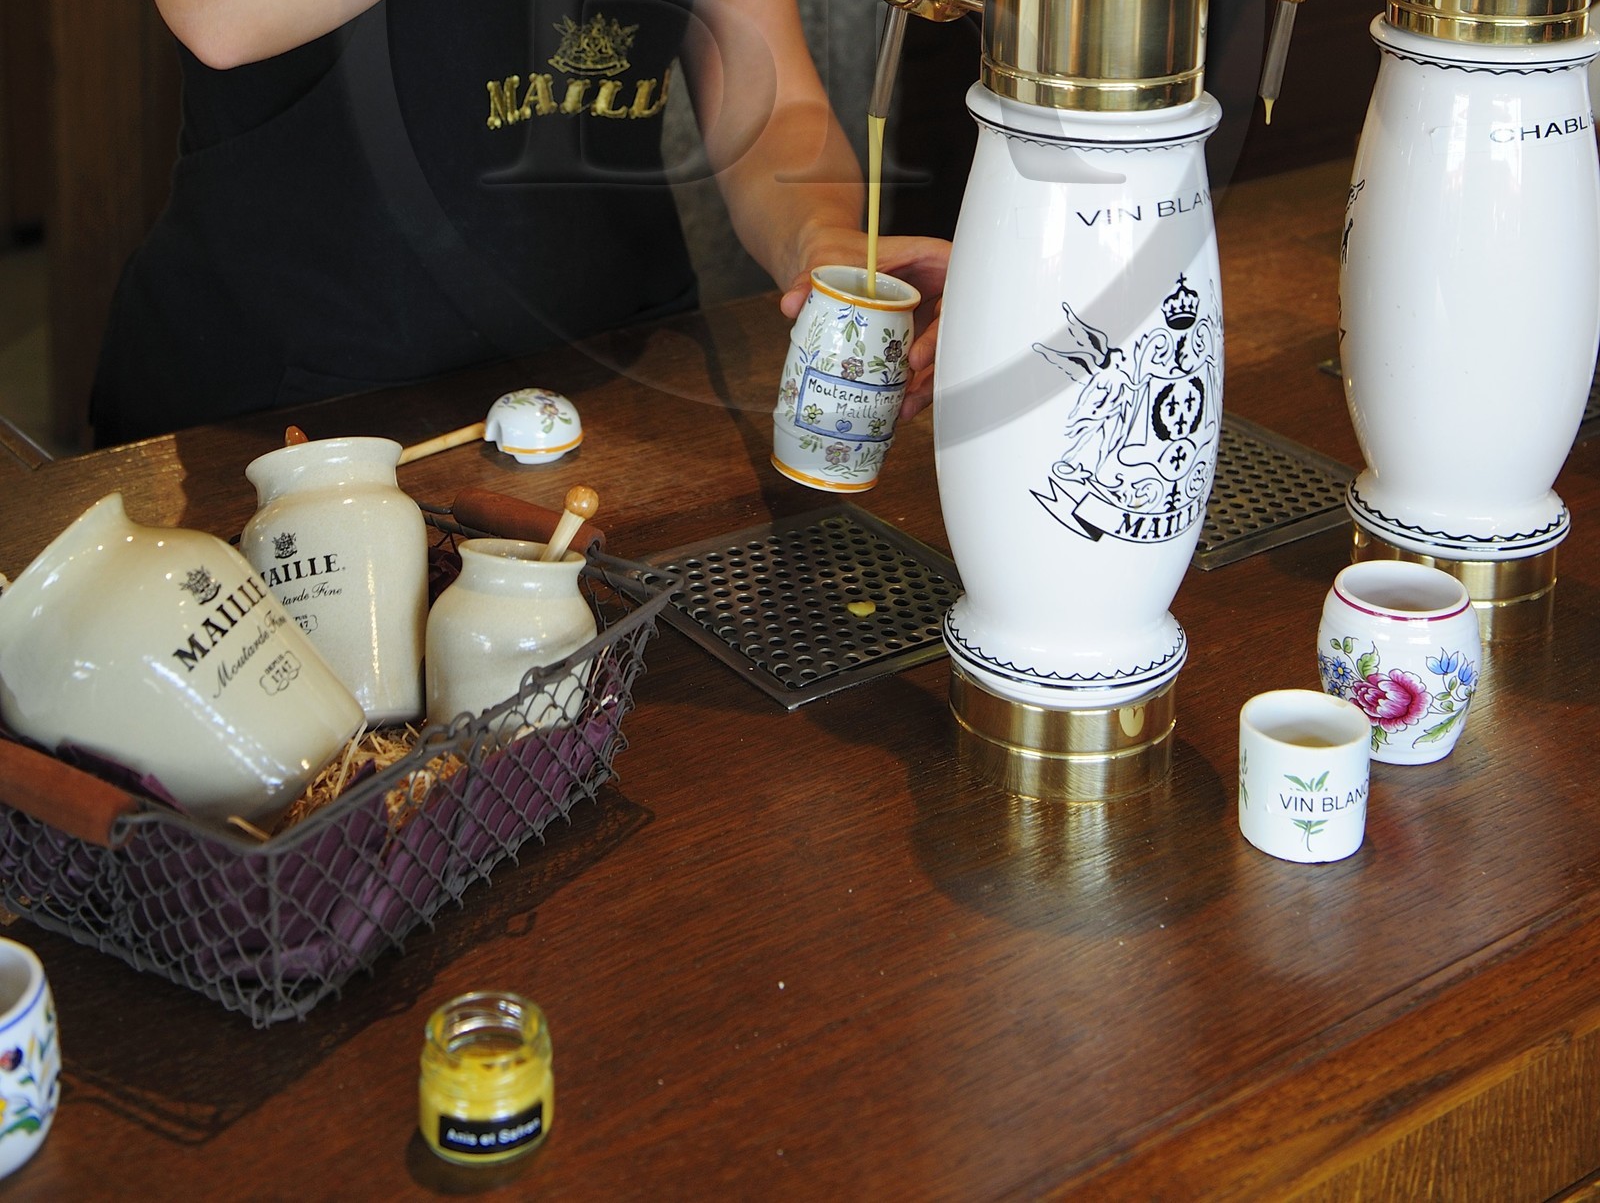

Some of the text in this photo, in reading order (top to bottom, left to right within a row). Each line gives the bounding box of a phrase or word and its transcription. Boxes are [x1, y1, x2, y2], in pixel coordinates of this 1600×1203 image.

[486, 69, 671, 130] MAILL
[1076, 205, 1142, 227] VIN
[807, 378, 870, 404] Moutarde
[280, 581, 343, 607] tarde Fine
[172, 576, 267, 673] MAILLE
[212, 625, 270, 699] Moutarde
[271, 660, 292, 683] 1747
[1279, 792, 1314, 813] VIN
